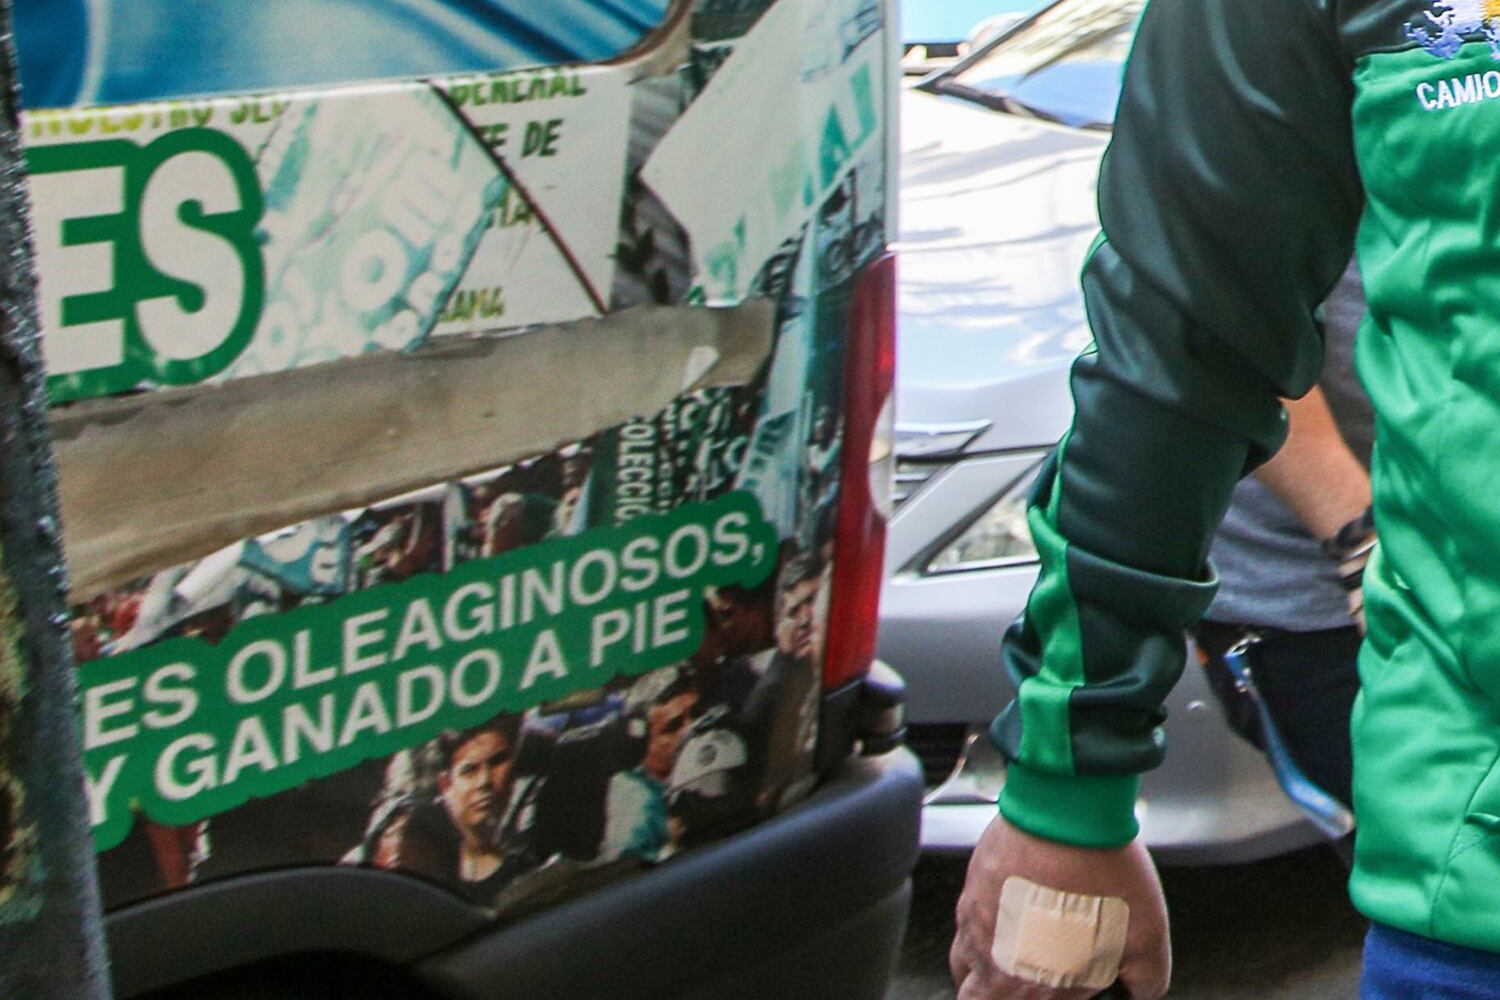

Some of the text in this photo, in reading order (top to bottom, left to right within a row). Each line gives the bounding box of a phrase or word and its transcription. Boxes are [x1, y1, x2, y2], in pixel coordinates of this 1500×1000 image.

[520, 117, 564, 157] DE
[26, 149, 245, 376] ES
[84, 511, 765, 750] ES OLEAGINOSOS,
[84, 589, 690, 827] Y GANADO A PIE
